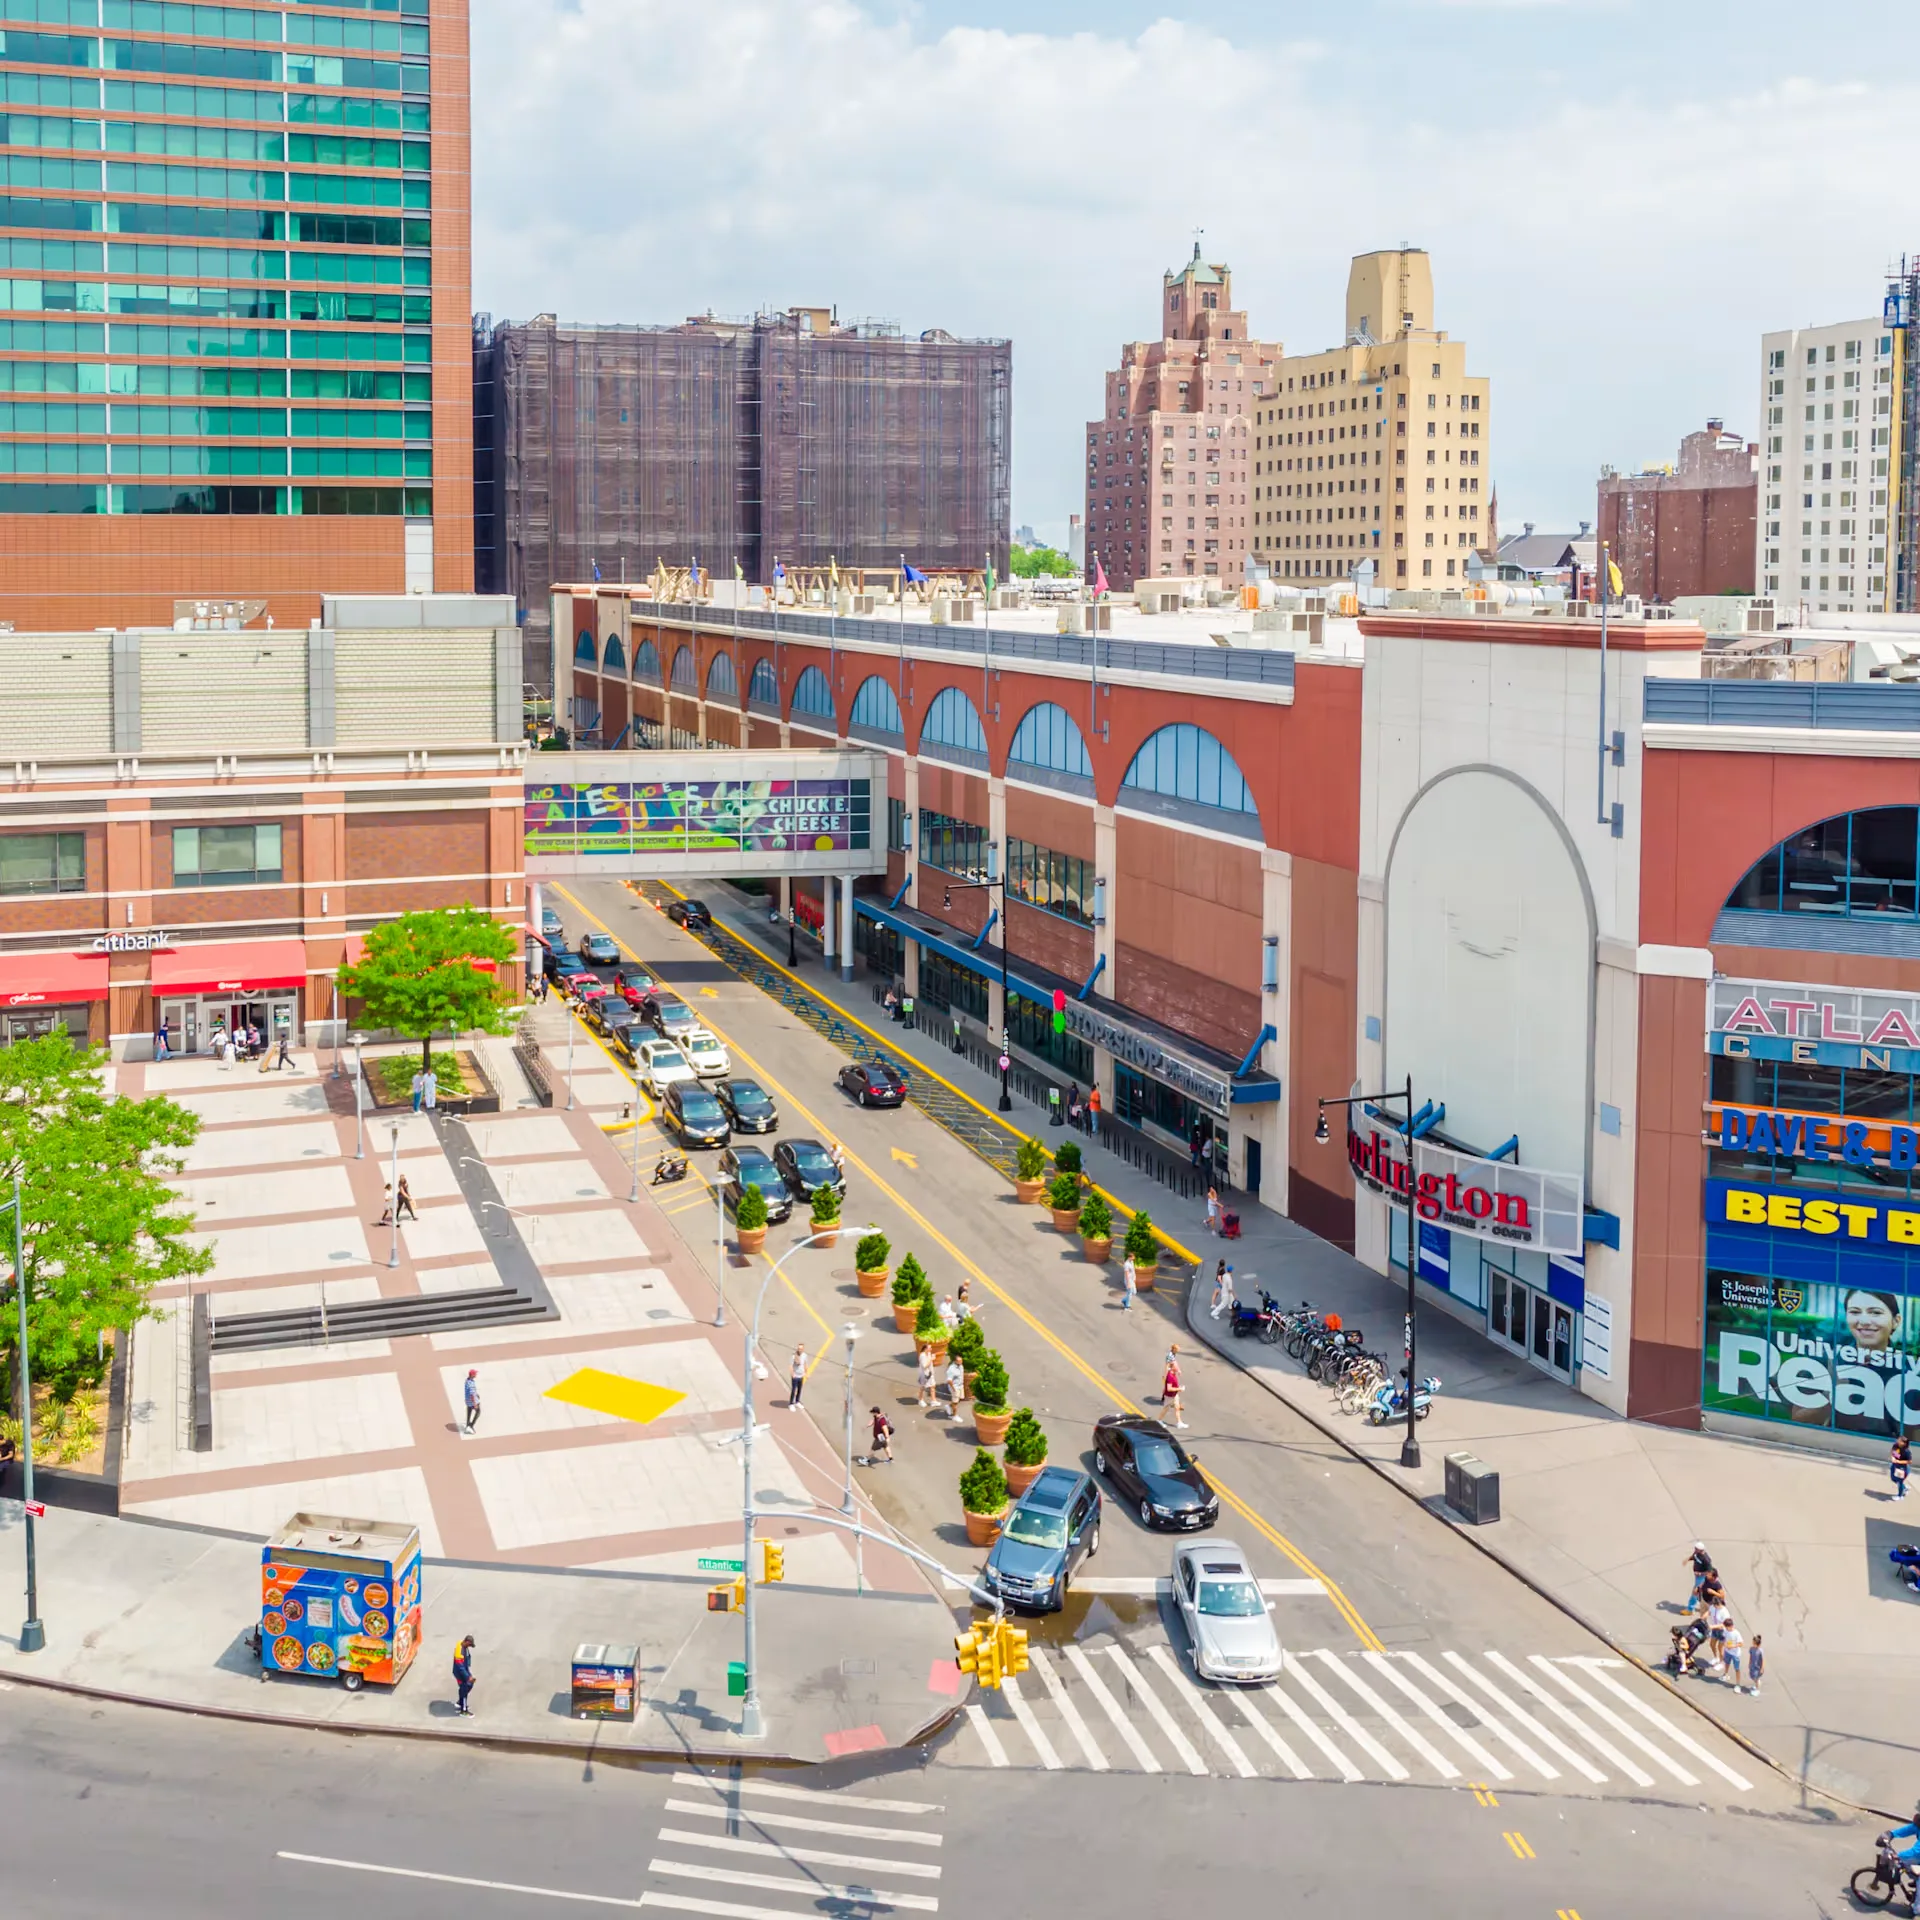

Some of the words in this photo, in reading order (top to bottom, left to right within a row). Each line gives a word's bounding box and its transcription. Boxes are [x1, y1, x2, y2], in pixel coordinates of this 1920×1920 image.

[768, 798, 830, 813] CHUCK
[773, 816, 840, 831] CHEESE
[93, 931, 169, 952] citibank
[1722, 1108, 1830, 1161] DAVE
[1842, 1122, 1876, 1167] &
[1726, 1189, 1878, 1239] BEST
[1733, 1280, 1776, 1297] Josephs
[1722, 1289, 1777, 1307] University
[1776, 1330, 1920, 1377] University
[698, 1559, 734, 1571] Atlantic
